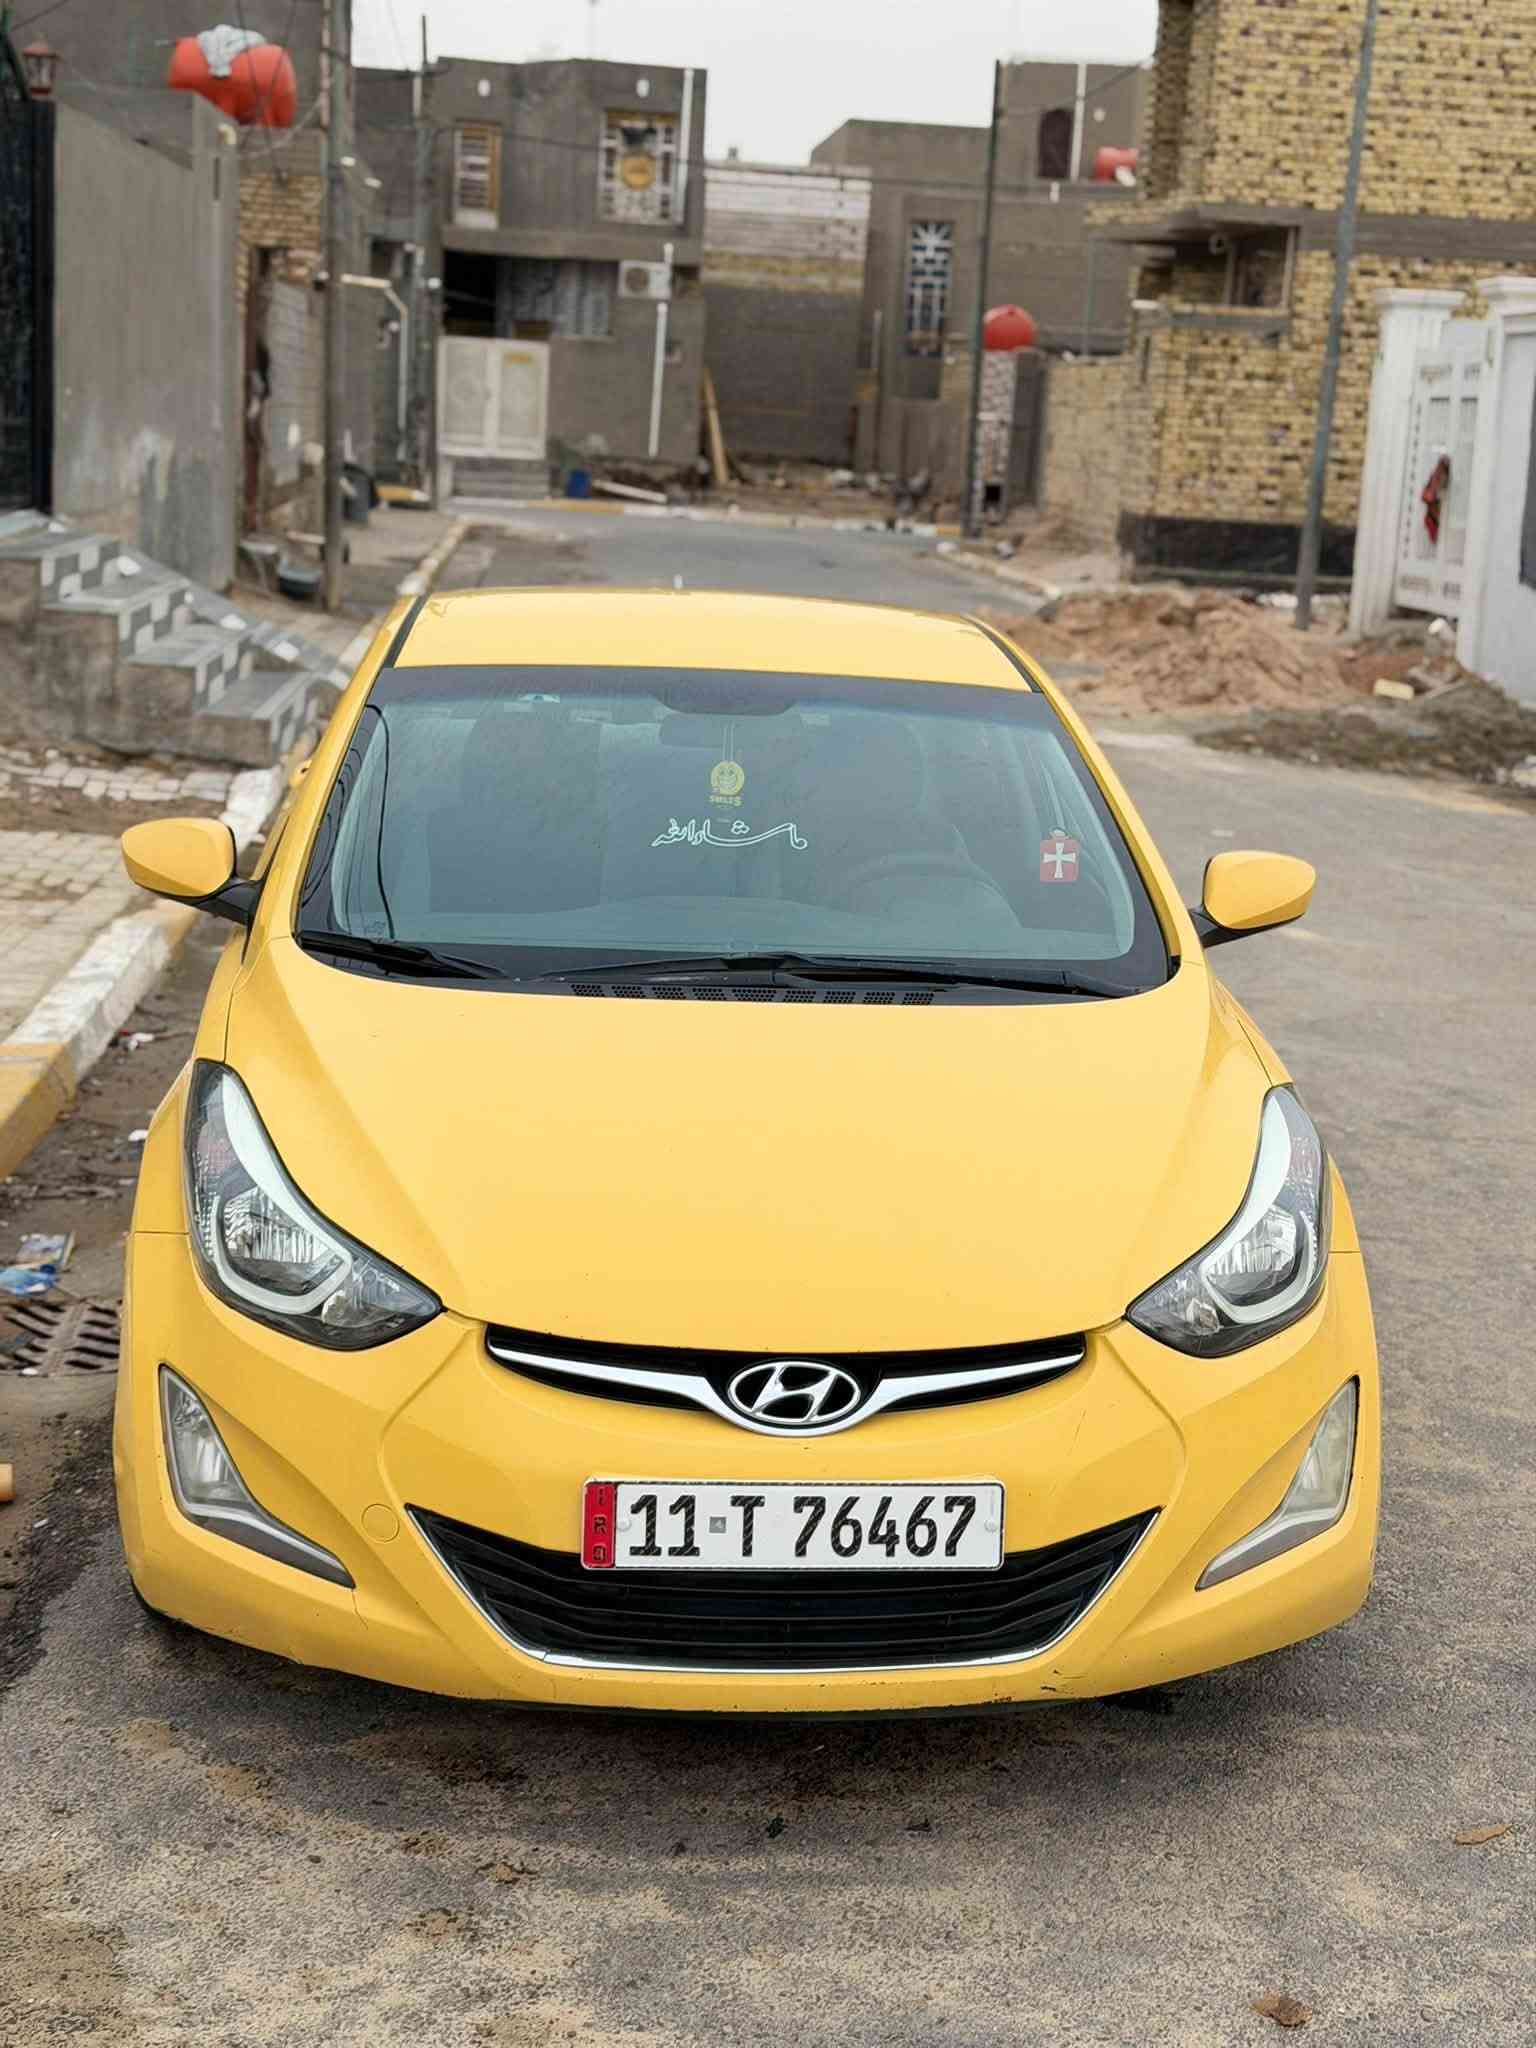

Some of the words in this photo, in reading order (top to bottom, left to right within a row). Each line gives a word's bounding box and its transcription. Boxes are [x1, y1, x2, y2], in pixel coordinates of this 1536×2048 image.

[591, 1487, 608, 1561] IRQ
[629, 1494, 701, 1557] 11
[731, 1495, 765, 1557] T
[793, 1496, 977, 1557] 76467
